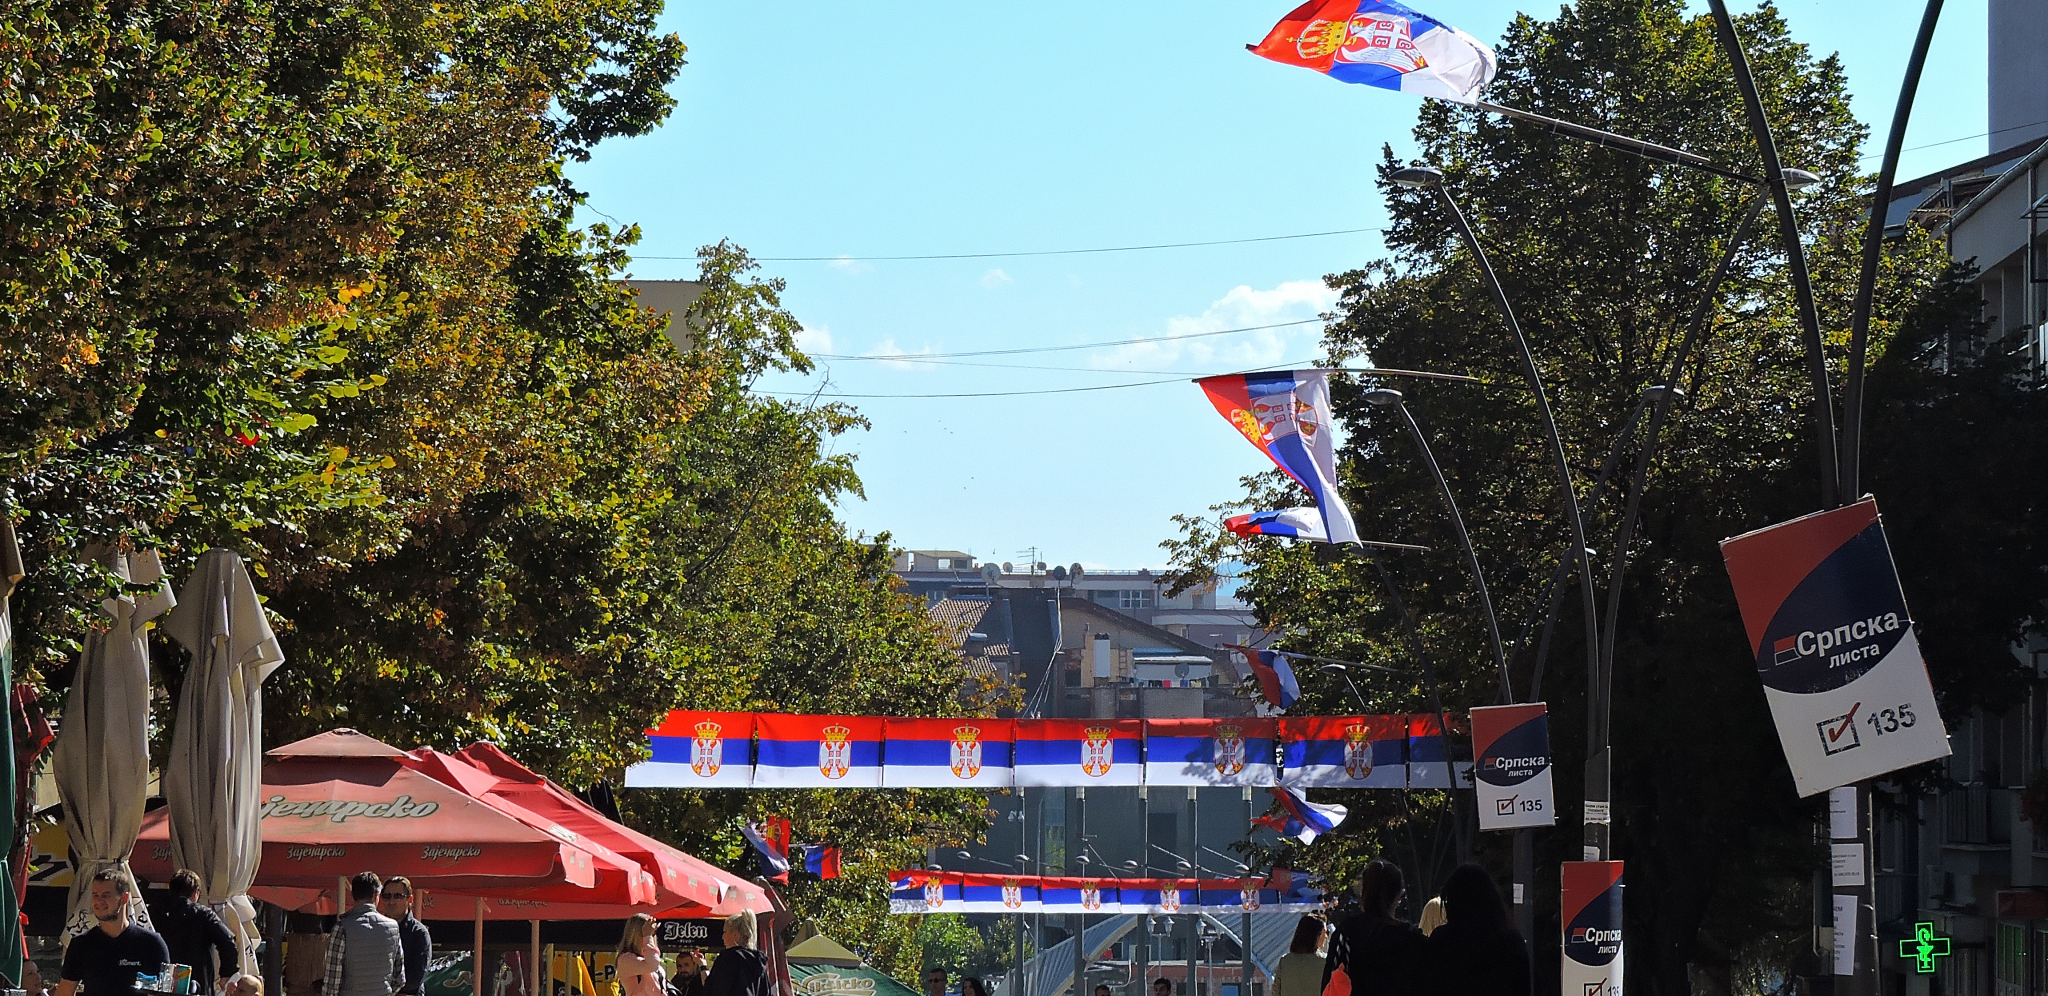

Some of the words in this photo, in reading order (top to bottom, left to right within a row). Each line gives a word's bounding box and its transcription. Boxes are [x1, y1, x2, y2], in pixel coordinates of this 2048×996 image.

[1796, 611, 1900, 657] Српска
[1829, 643, 1880, 669] листа
[1867, 702, 1917, 737] 135
[1496, 756, 1545, 771] Српска
[1508, 769, 1533, 777] листа
[1519, 800, 1543, 812] 135
[287, 844, 346, 861] Зајечарско
[421, 844, 481, 861] Зајечарско
[664, 921, 708, 940] Jelen
[1585, 927, 1622, 946] Српска
[1597, 945, 1617, 954] листа
